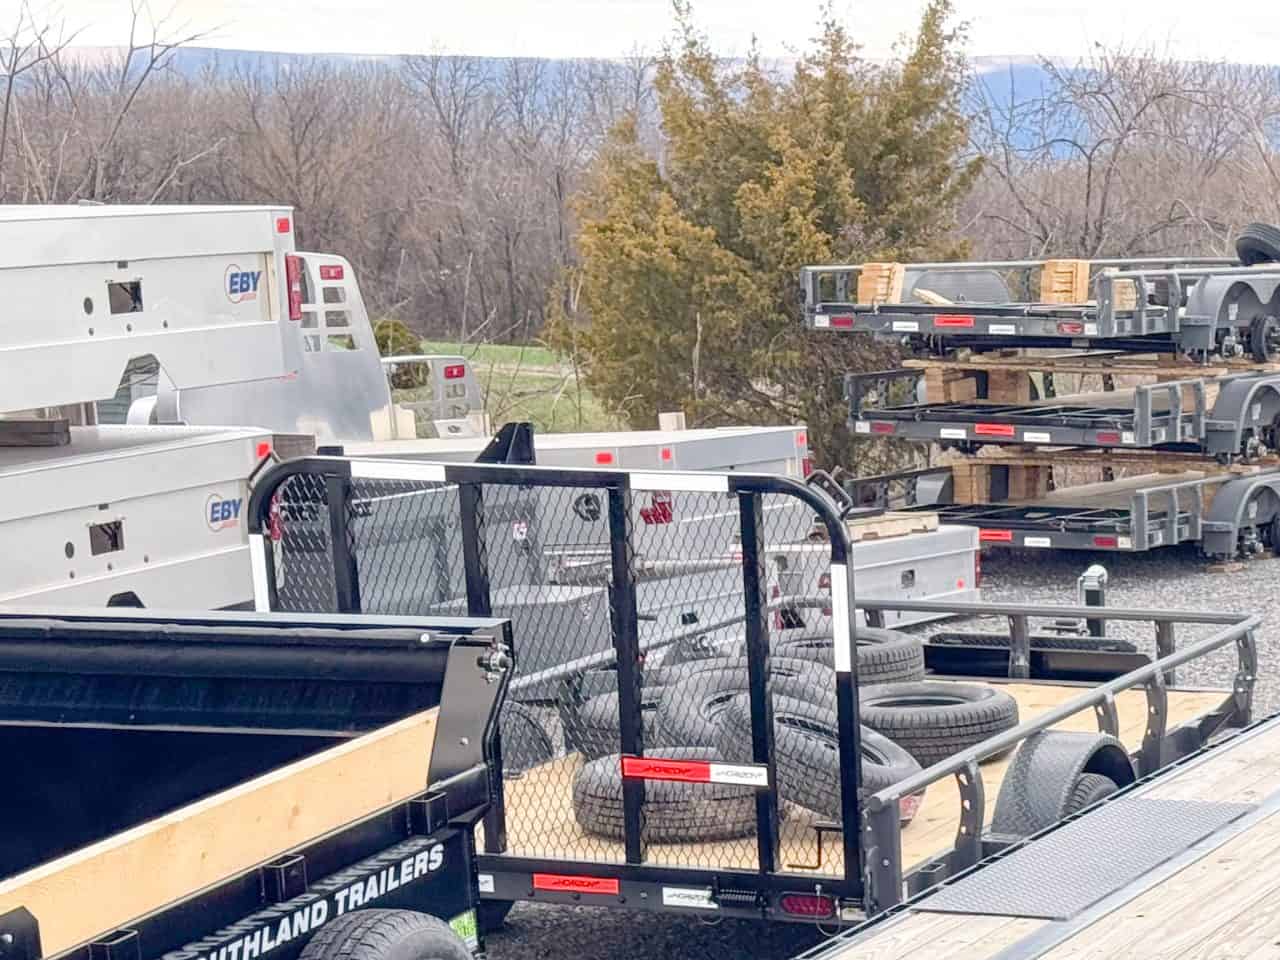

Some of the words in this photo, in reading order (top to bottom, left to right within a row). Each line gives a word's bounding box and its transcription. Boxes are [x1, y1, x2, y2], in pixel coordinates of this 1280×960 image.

[229, 270, 262, 294] EBY
[210, 498, 243, 522] EBY
[335, 844, 444, 914] TRAILERS
